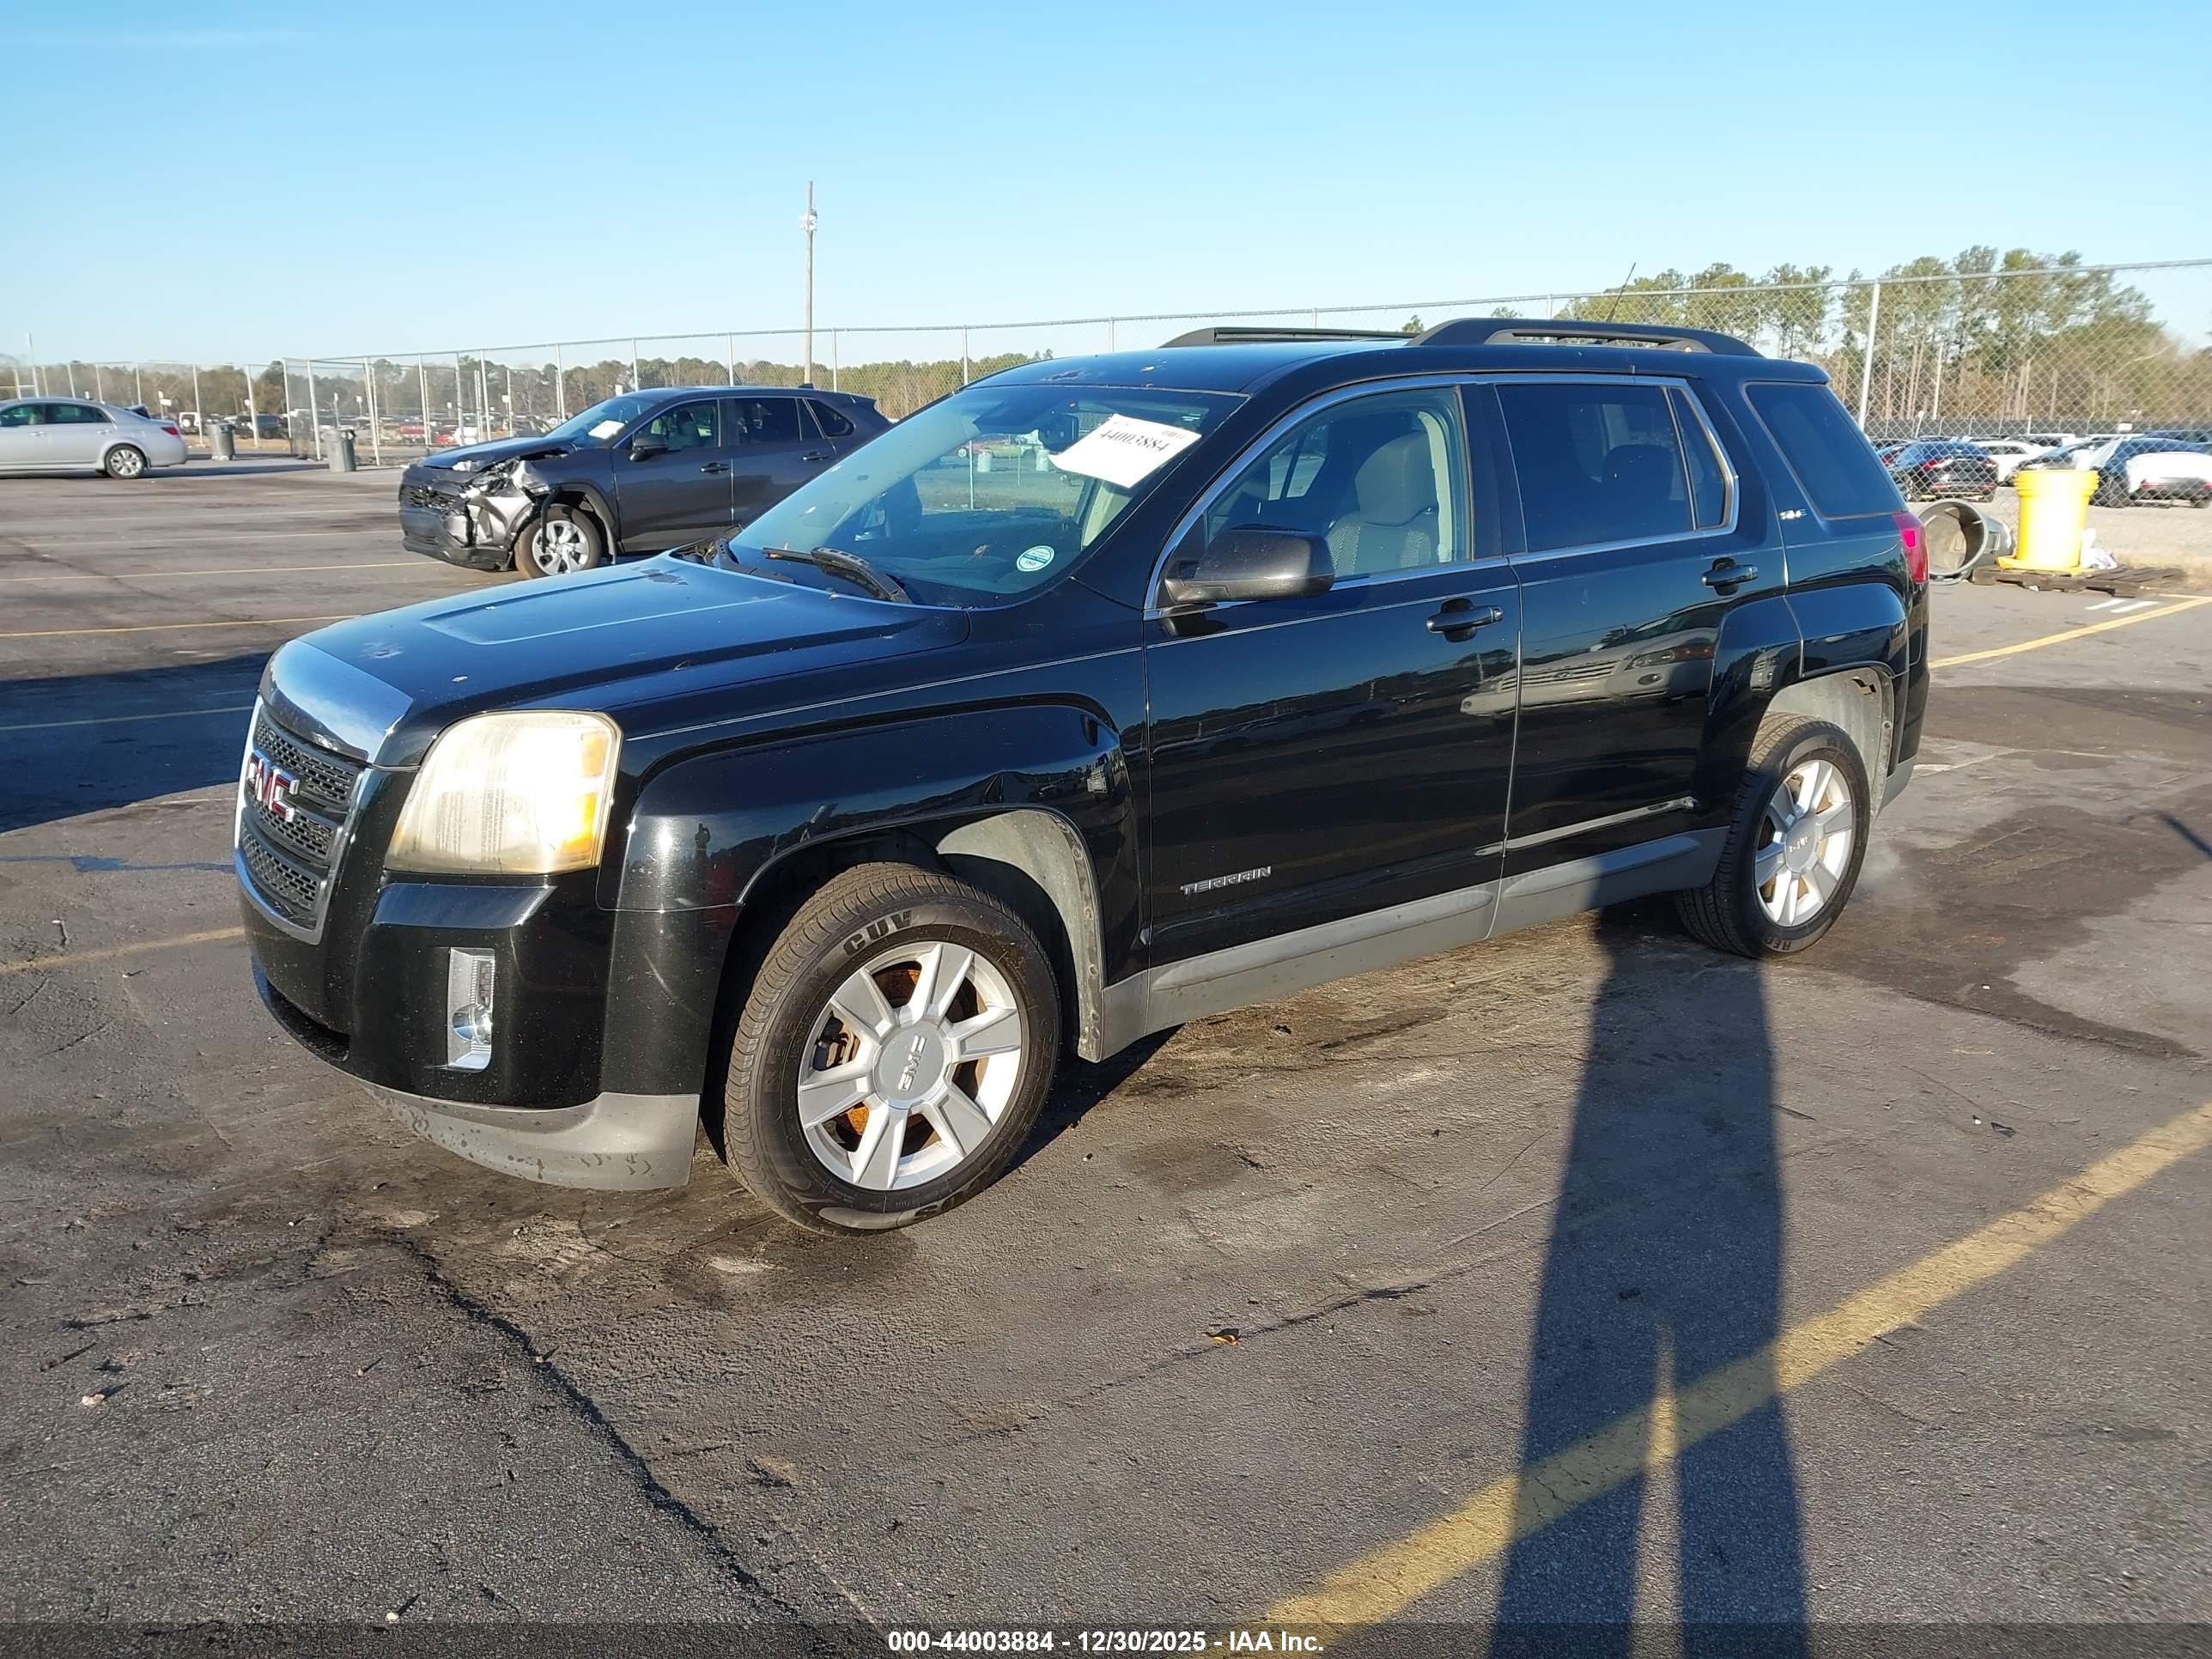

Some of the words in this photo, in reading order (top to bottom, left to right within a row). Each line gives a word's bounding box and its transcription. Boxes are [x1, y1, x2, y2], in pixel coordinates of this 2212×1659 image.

[1099, 429, 1170, 452] 44003884
[246, 749, 301, 823] GMC
[1180, 866, 1272, 896] TERRAIN
[842, 910, 912, 956] CUV
[897, 1034, 927, 1092] GMC
